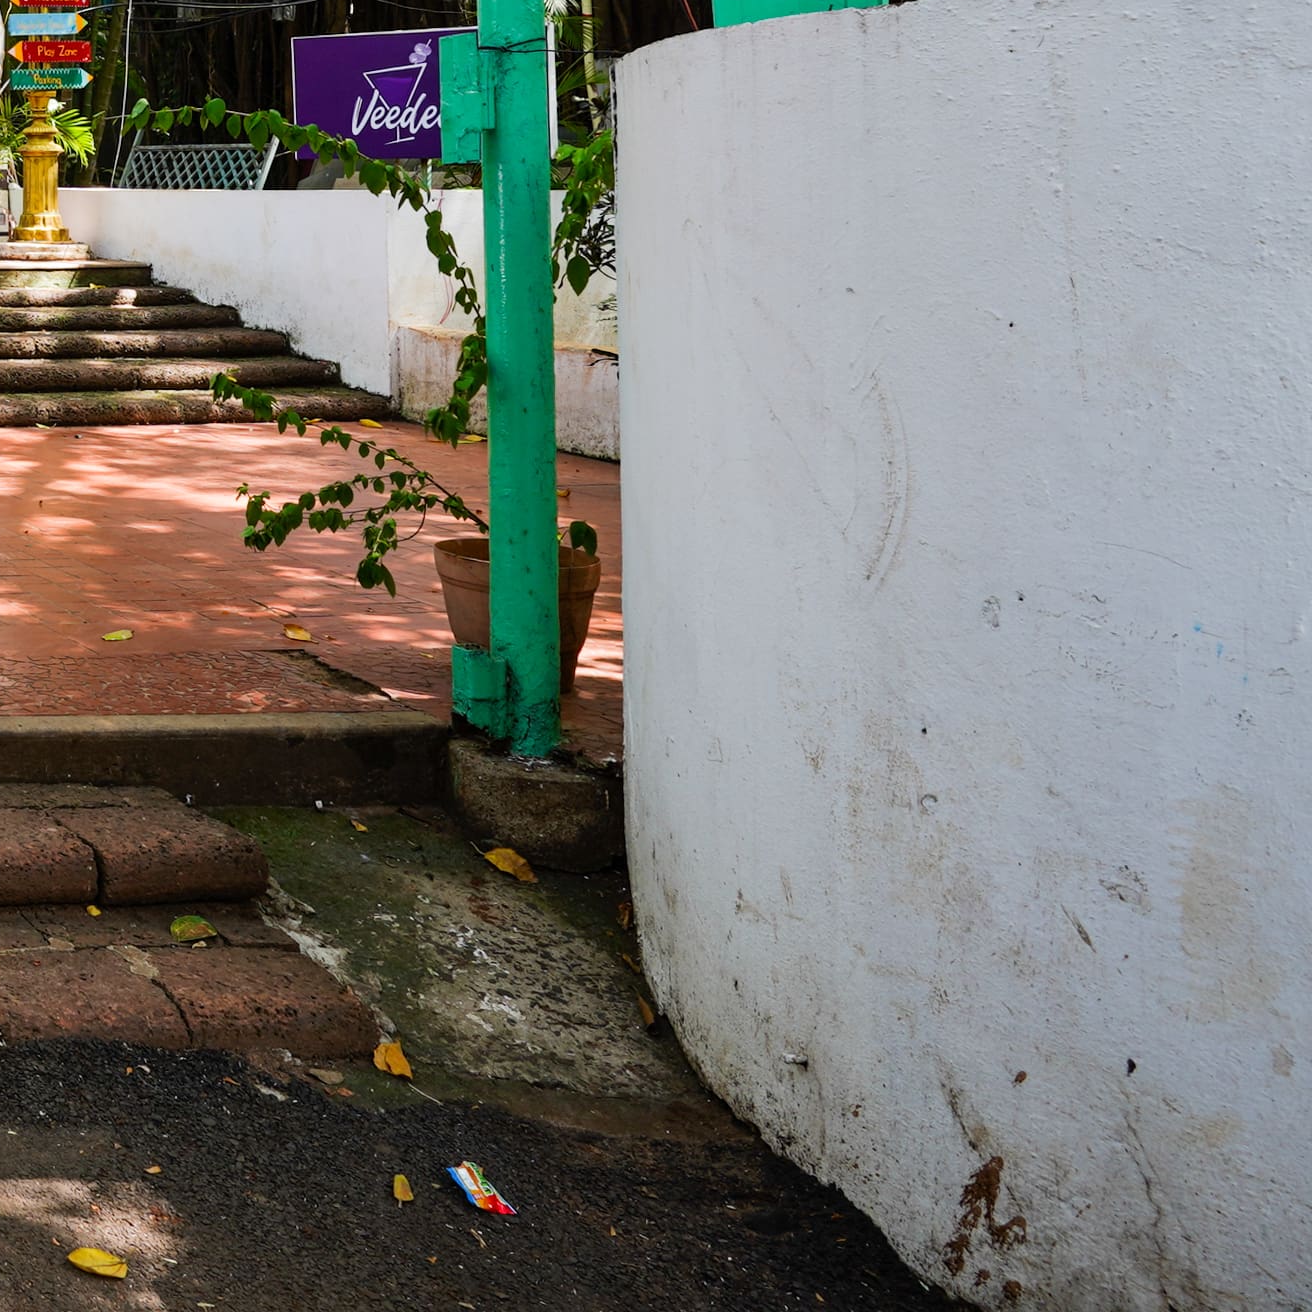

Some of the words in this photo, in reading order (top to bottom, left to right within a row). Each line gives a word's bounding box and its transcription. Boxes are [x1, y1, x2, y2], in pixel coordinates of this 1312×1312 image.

[37, 45, 56, 57] Play
[58, 45, 78, 57] Zone
[33, 73, 62, 88] Parking
[351, 89, 442, 136] Veede
